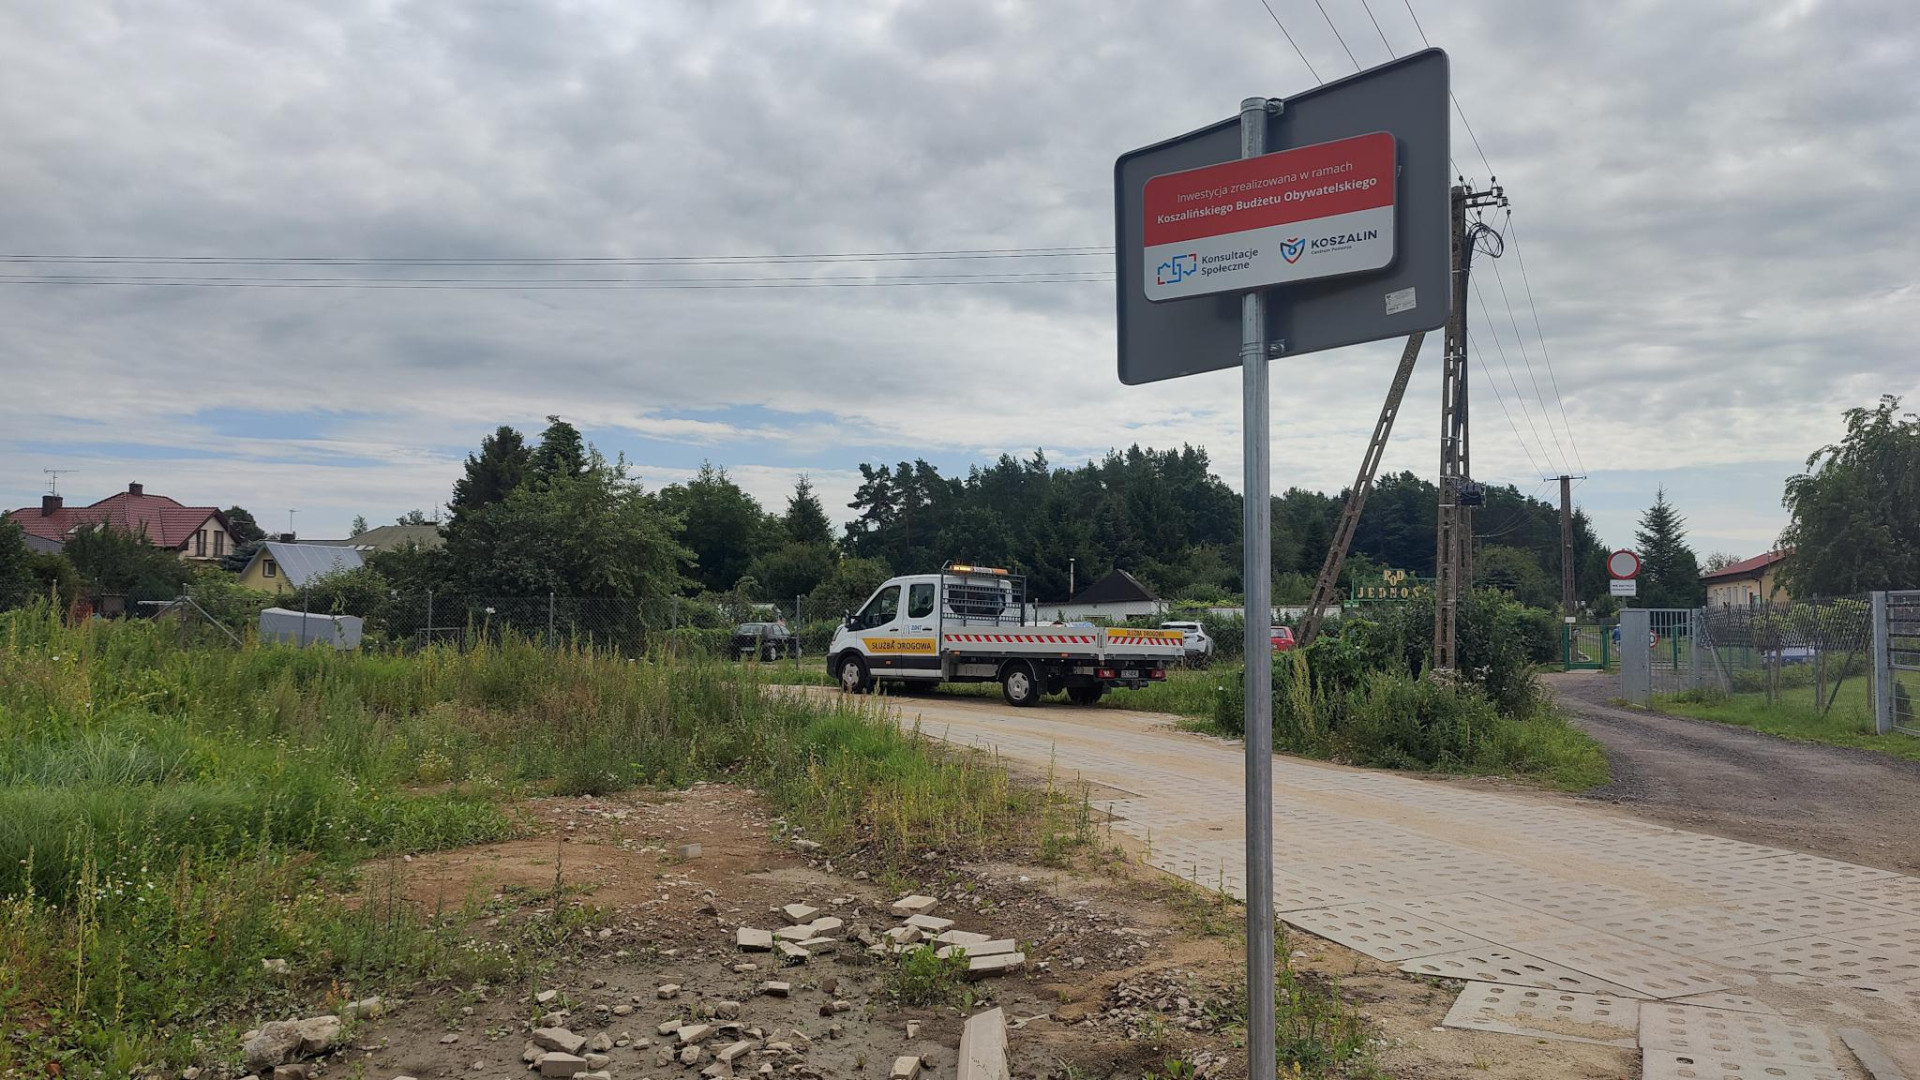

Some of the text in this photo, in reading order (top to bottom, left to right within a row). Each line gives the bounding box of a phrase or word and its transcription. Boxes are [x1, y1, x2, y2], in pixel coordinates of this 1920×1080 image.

[1177, 160, 1353, 203] Inwestycja zrealizowana w ramach
[1157, 177, 1377, 224] Koszalińskiego Budżetu Obywatelskiego
[1311, 229, 1378, 249] KOSZALIN
[1201, 247, 1259, 264] Konsultacje
[1201, 261, 1250, 277] Społeczne
[897, 642, 932, 650] DROGOWA
